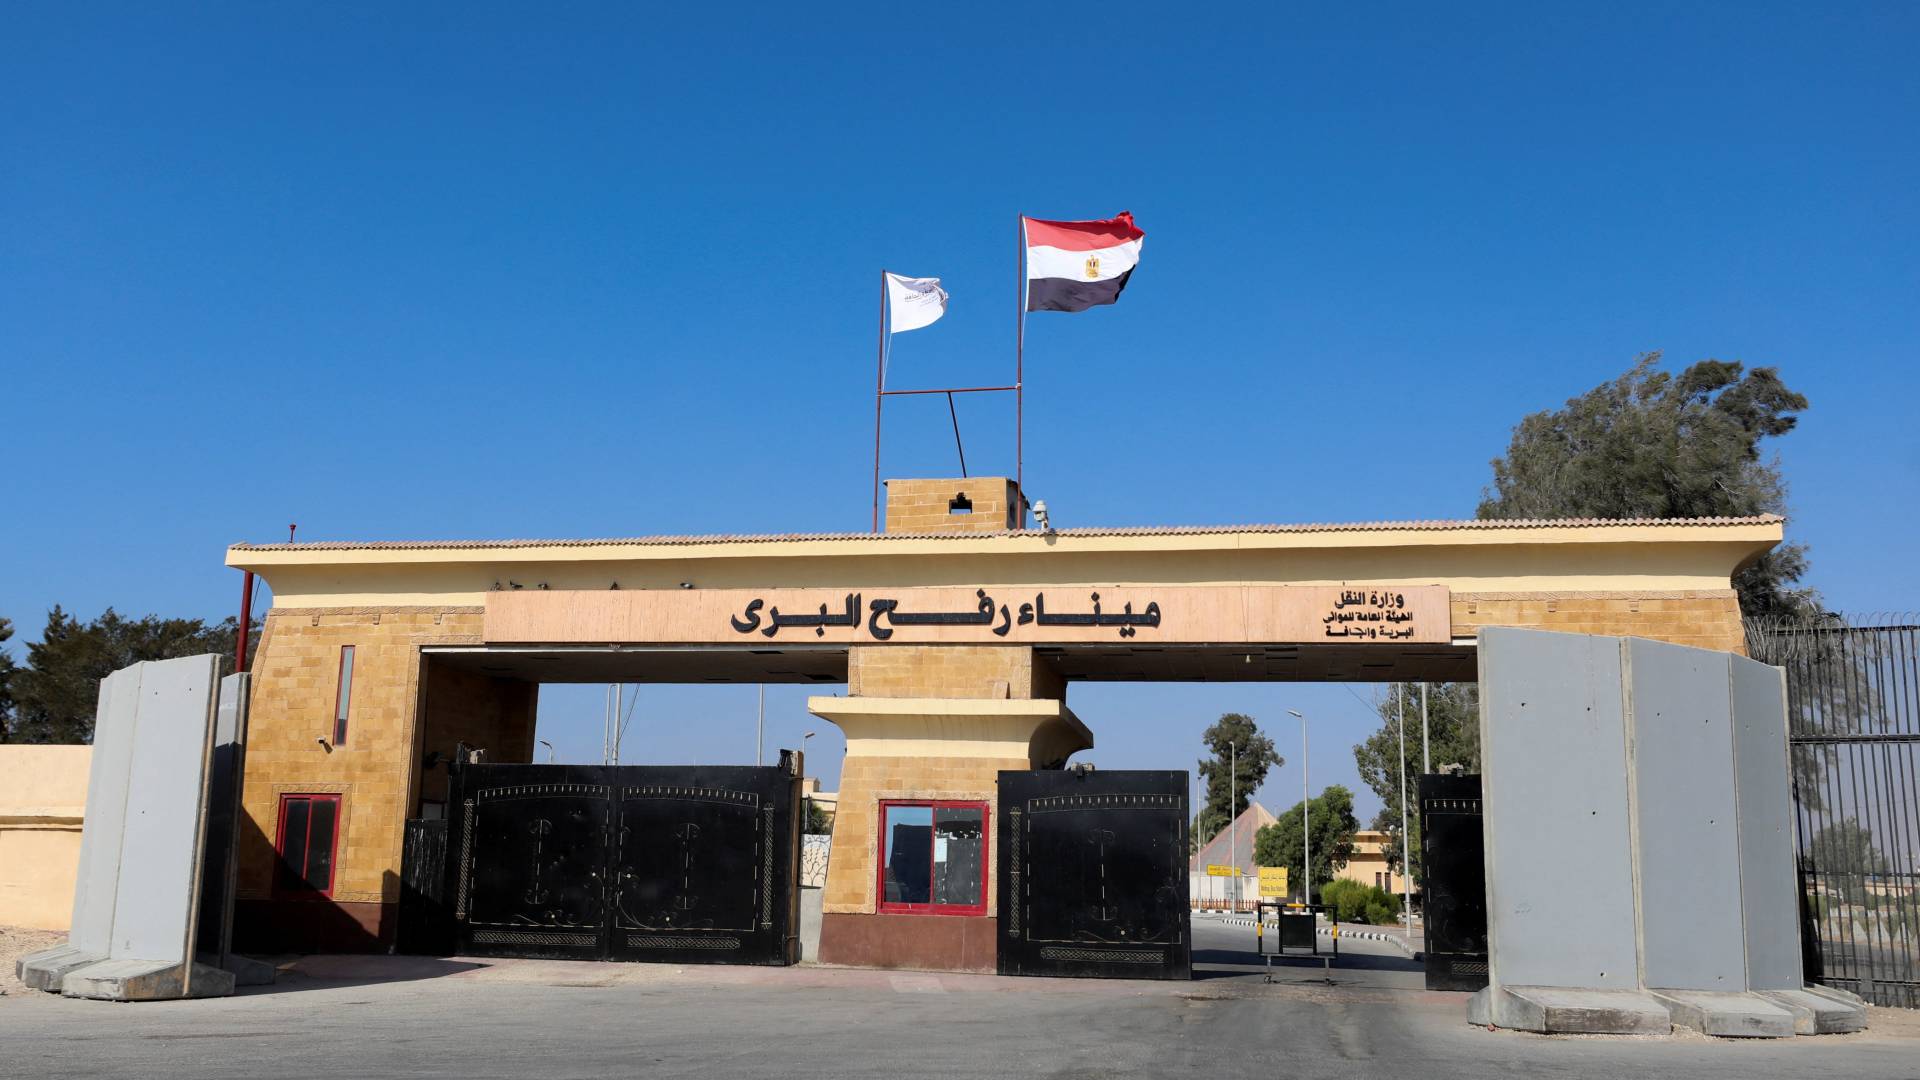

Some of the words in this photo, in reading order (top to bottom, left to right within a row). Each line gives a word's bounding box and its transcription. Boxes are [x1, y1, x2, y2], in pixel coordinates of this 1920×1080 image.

[1334, 590, 1366, 610] النقل
[1370, 590, 1404, 609] وزارة
[868, 588, 1012, 641] رفح
[1017, 591, 1162, 638] ميناء
[1355, 611, 1384, 622] العامة
[1385, 610, 1413, 624] الهيئة
[1379, 625, 1414, 640] البرية
